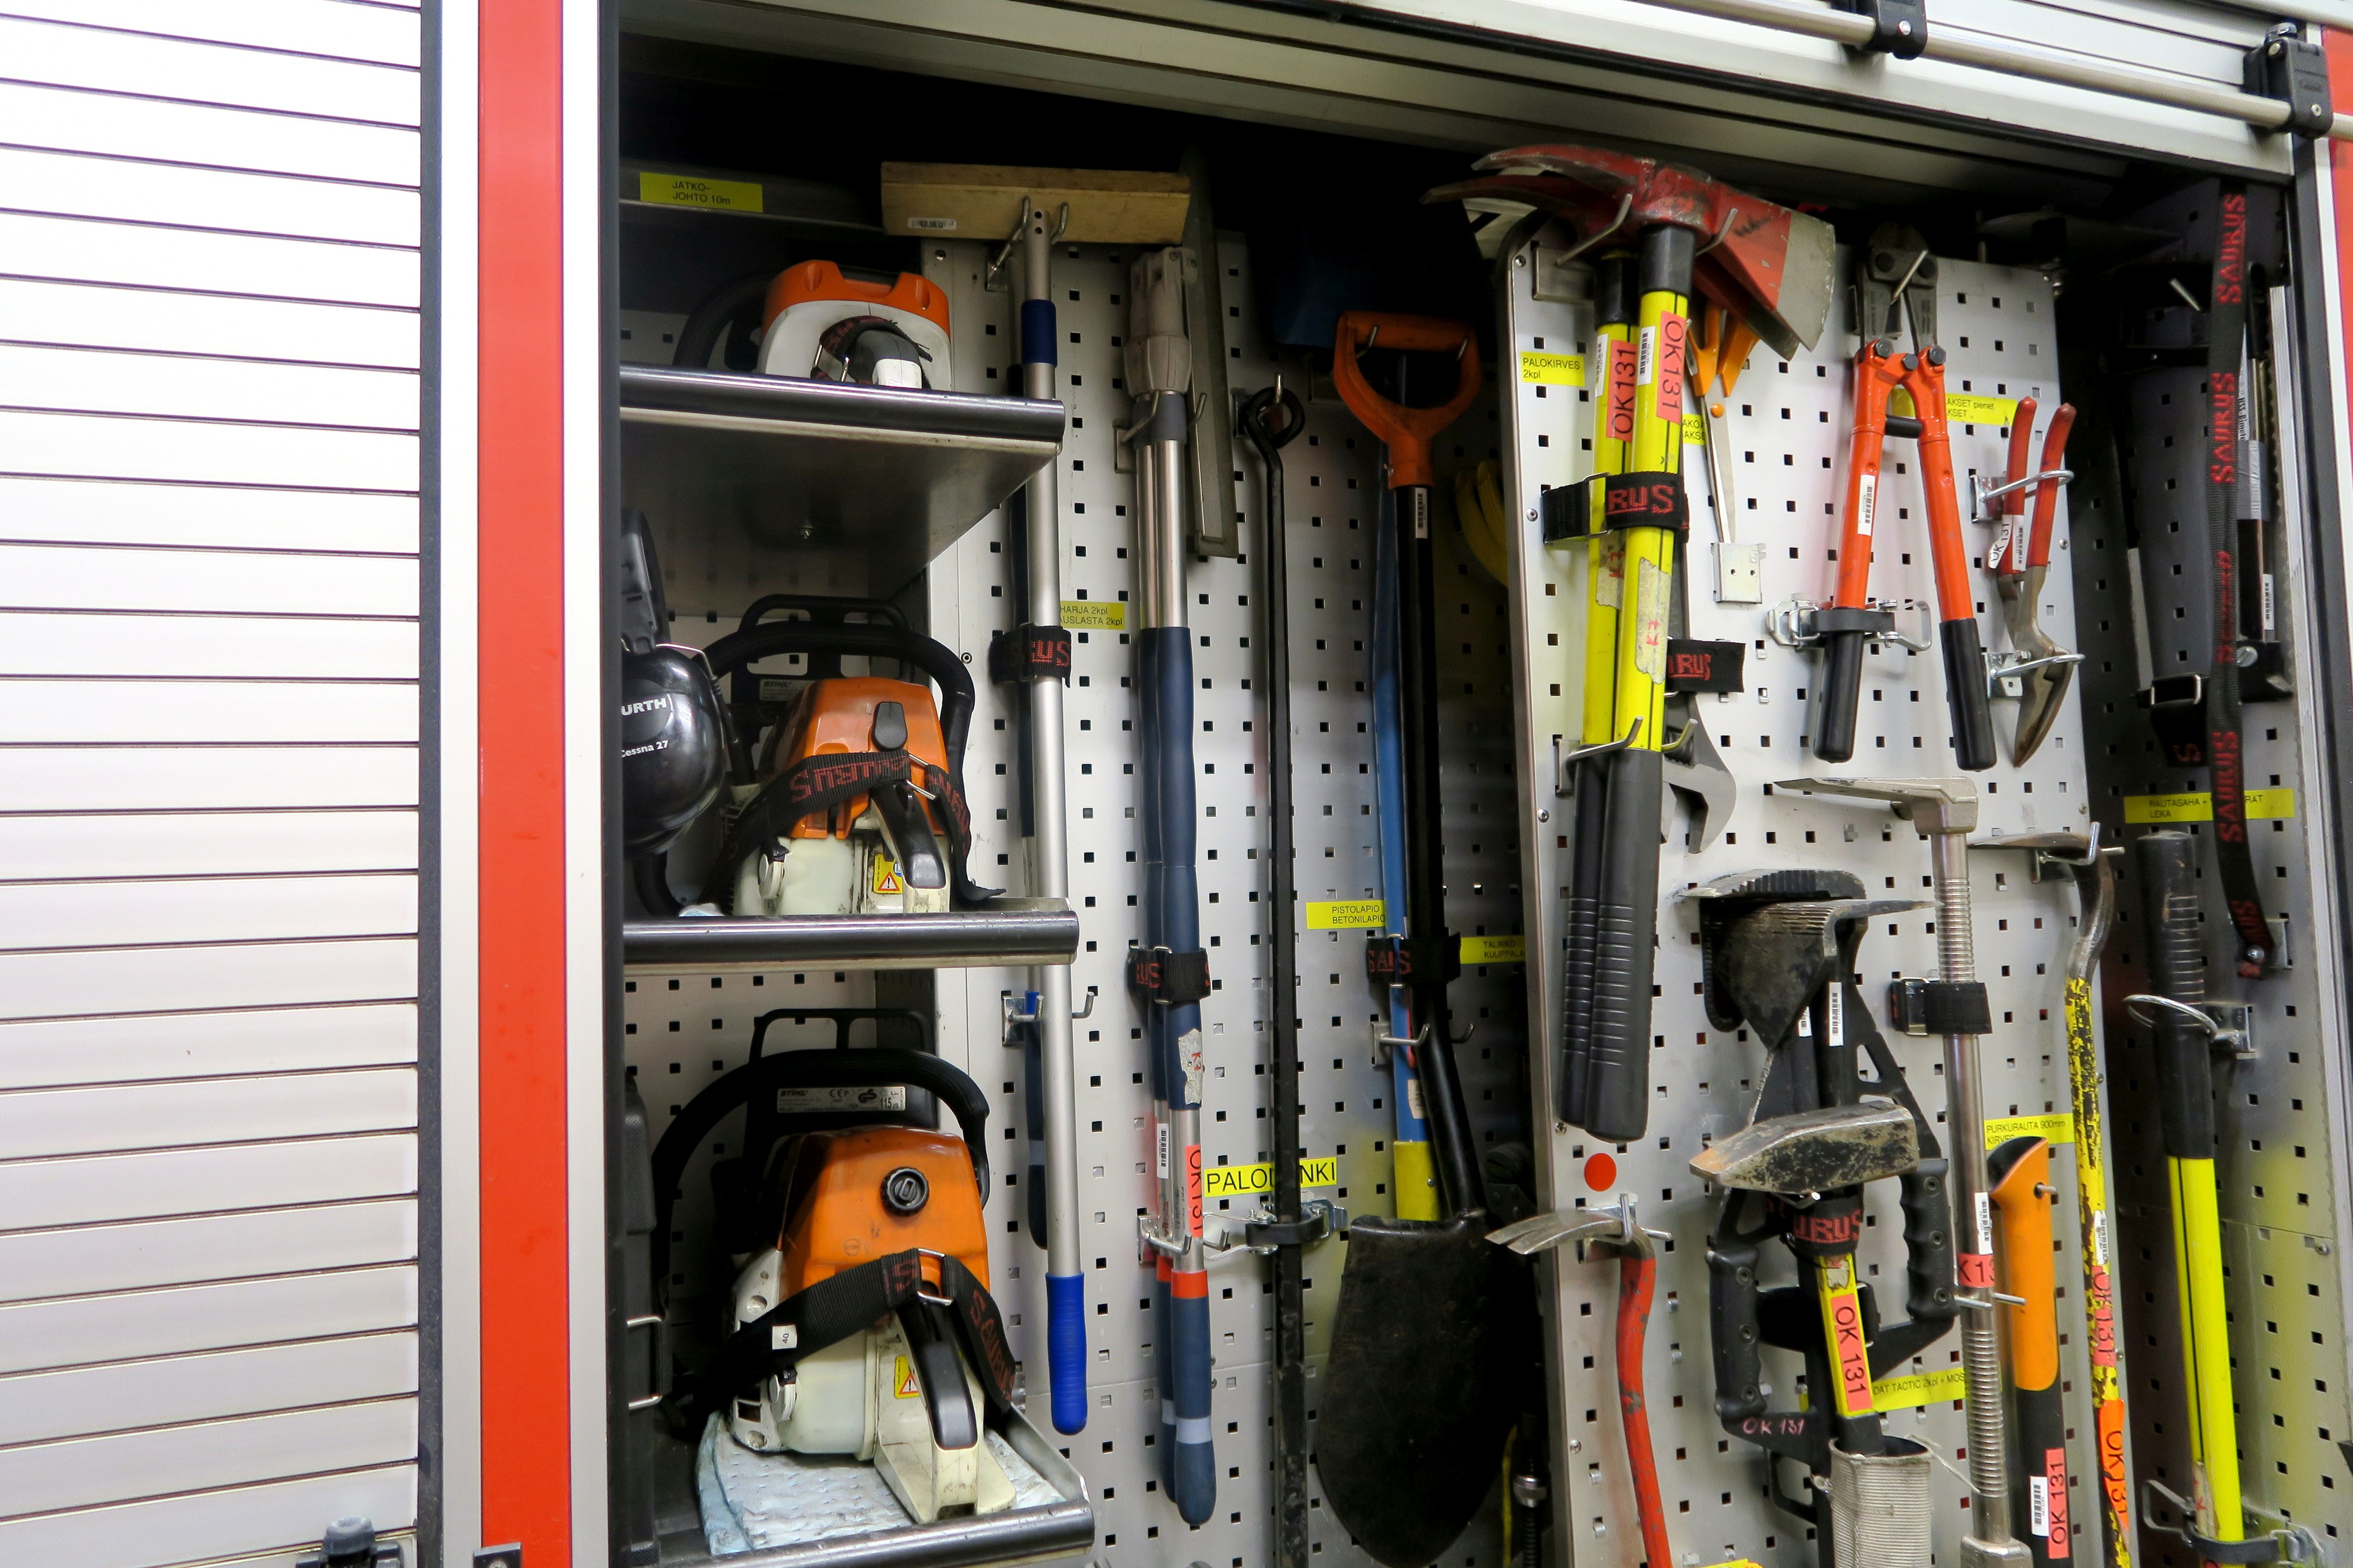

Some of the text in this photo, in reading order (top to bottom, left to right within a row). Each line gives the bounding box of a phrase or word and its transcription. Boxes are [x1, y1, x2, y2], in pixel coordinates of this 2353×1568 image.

[672, 181, 712, 192] JATKO-
[672, 192, 731, 205] JOHTO 10m
[2217, 194, 2245, 303] SAURUS
[1522, 357, 1580, 370] PALOKIRVES
[1522, 369, 1541, 379] 2kpl
[2209, 373, 2235, 483] SAURUS
[1091, 606, 1108, 615] 2kpl
[1106, 618, 1122, 626] 2kpl
[656, 740, 669, 750] 27
[1332, 905, 1380, 914] PISTOLAPIO
[1332, 915, 1386, 924] BETONILAPIO
[1484, 940, 1516, 949] TALIKKO
[782, 1333, 789, 1344] 40
[1835, 1306, 1867, 1394] OK 131
[1892, 1380, 1921, 1392] TACTIC
[1742, 1417, 1772, 1435] OK
[2049, 1462, 2067, 1544] OK 131
